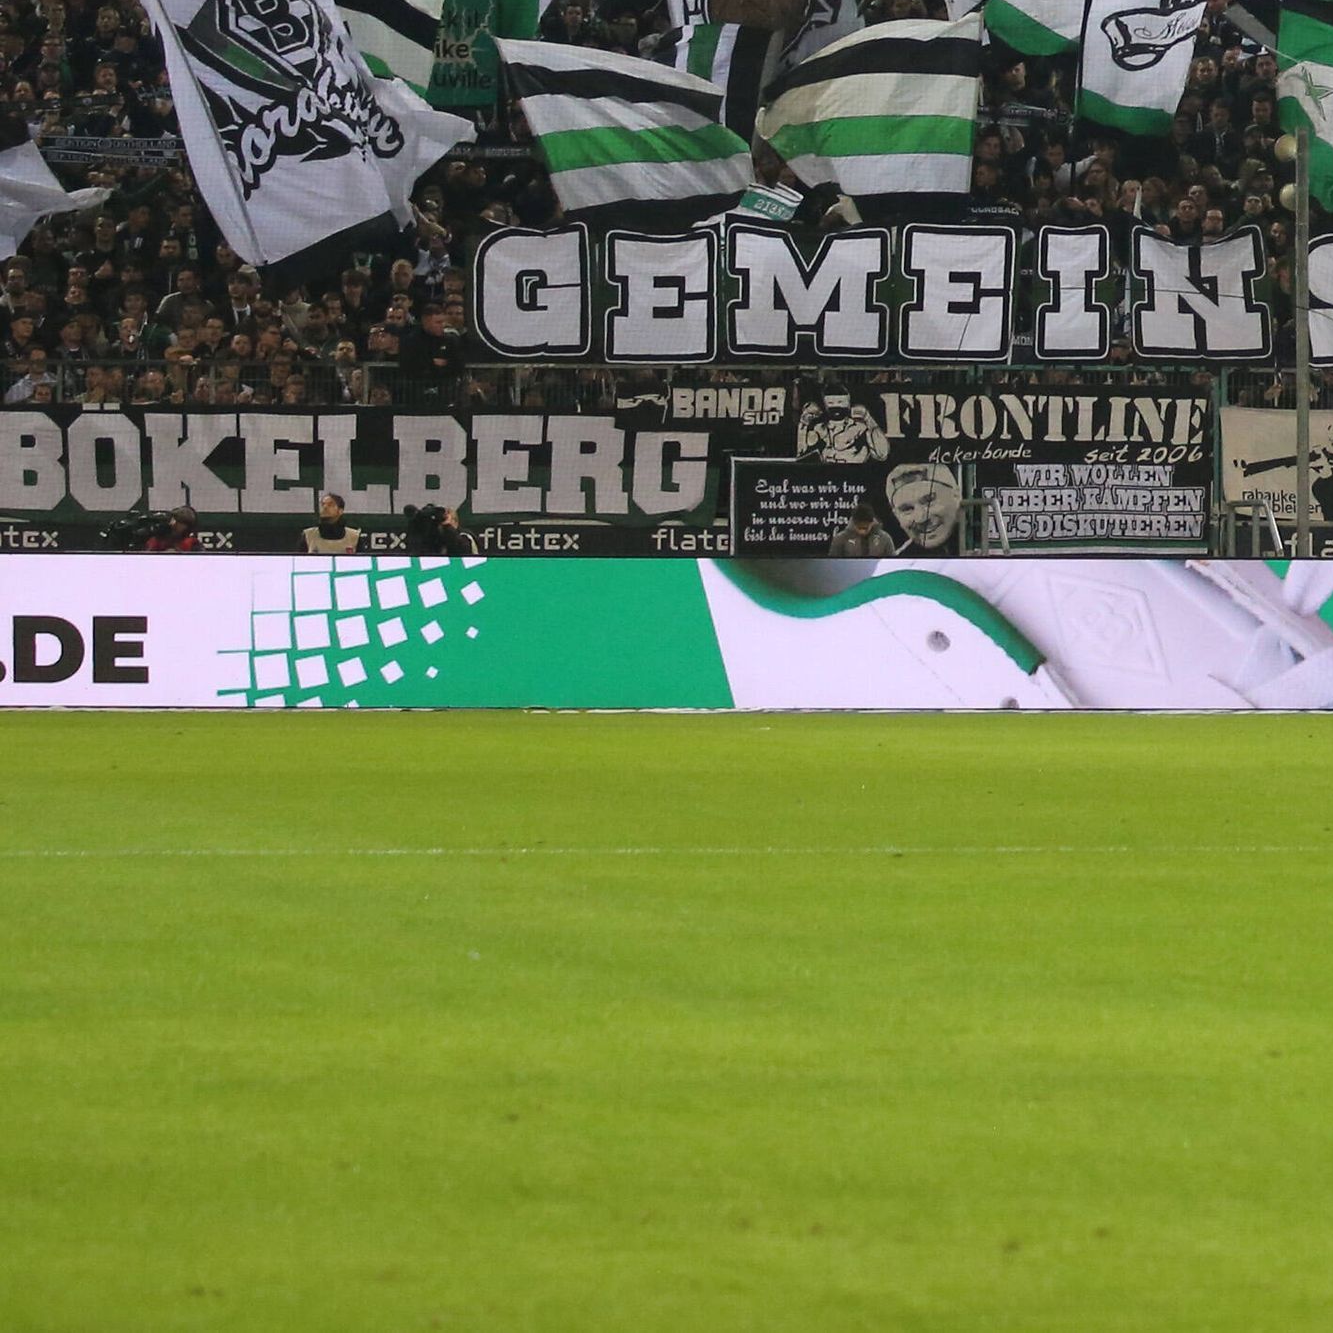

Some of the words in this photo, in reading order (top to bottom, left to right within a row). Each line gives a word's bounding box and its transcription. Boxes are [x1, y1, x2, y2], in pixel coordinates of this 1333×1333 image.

[672, 386, 787, 419] BANDA
[742, 410, 784, 427] SUD
[879, 392, 1208, 445] FRONTLINE
[928, 442, 1032, 464] Ackerbande
[1083, 444, 1130, 464] seit
[1136, 444, 1203, 464] 2006
[1014, 463, 1068, 487] WIR
[1069, 463, 1175, 487] WOLLEN
[755, 479, 790, 498] Egal
[791, 484, 816, 494] was
[818, 481, 841, 494] wir
[843, 481, 867, 494] tun
[759, 496, 789, 509] und
[789, 500, 808, 509] wo
[810, 497, 832, 509] wir
[1271, 501, 1324, 514] bleien
[752, 513, 766, 525] in
[768, 515, 820, 526] unseren
[822, 511, 851, 527] Her
[1034, 514, 1205, 540] DISKUTIEREN
[479, 526, 580, 551] flatex
[744, 527, 766, 542] bist
[768, 527, 789, 542] du
[789, 528, 831, 542] immer
